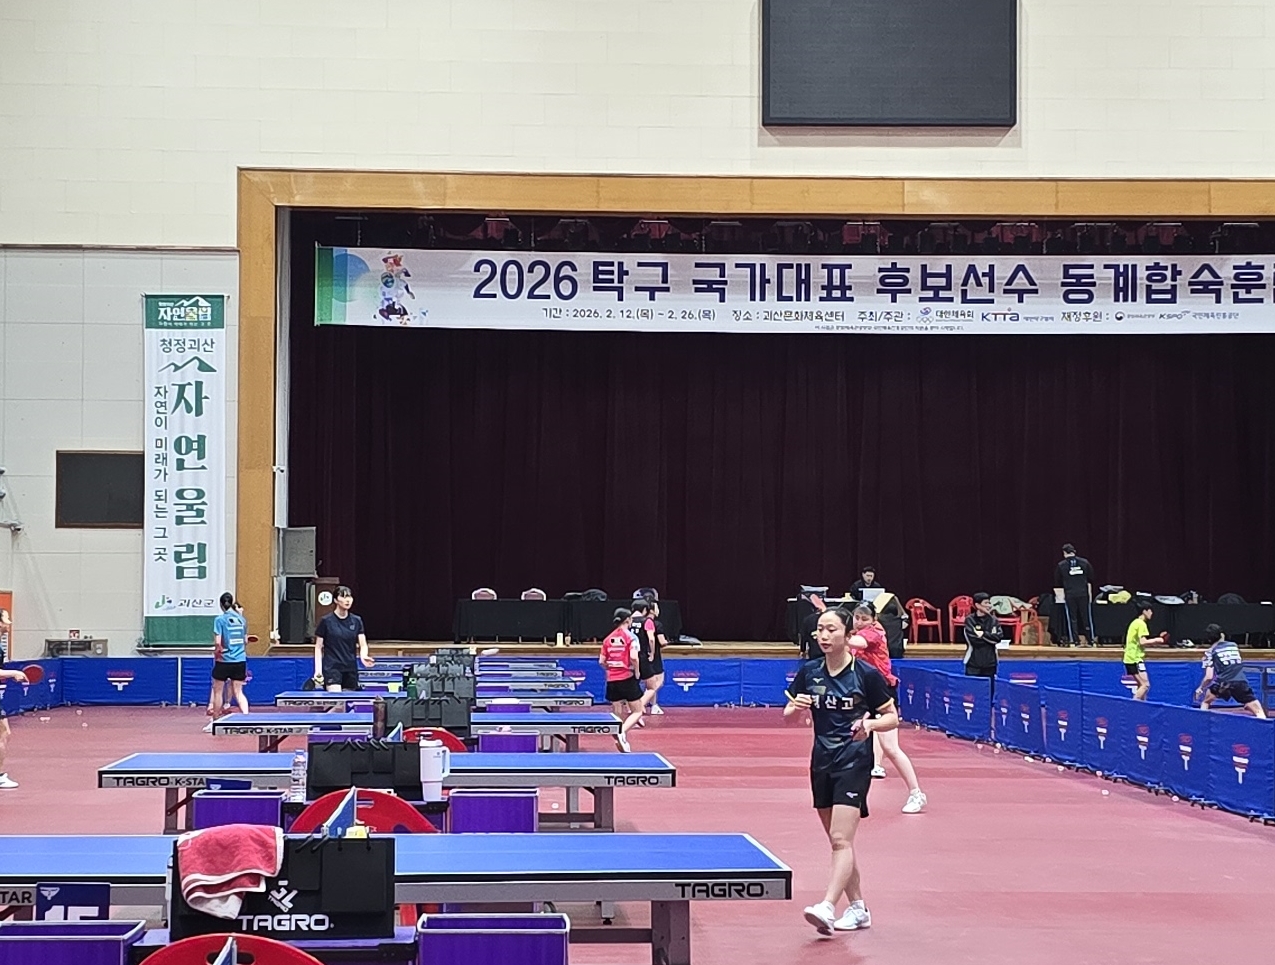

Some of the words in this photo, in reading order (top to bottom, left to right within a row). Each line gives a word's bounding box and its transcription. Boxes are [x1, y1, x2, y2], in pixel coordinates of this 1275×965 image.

[473, 259, 578, 299] 2026
[592, 260, 672, 302] 탁구
[691, 262, 855, 303] 국가대표
[876, 262, 1040, 304] 후보선수
[542, 308, 562, 318] 기간
[573, 309, 602, 318] 2026.
[732, 310, 752, 321] 장소
[858, 311, 903, 322] 주최/주관
[1061, 311, 1102, 322] 재정후원
[159, 337, 215, 353] 청정괴산
[154, 385, 169, 430] 자연이
[154, 439, 169, 483] 미래가
[170, 380, 210, 580] 자연울림
[154, 489, 169, 519] 되는
[153, 526, 169, 539] 그
[153, 547, 169, 562] 곳
[177, 598, 215, 609] 괴산군
[571, 726, 611, 734] TAGRO
[112, 777, 170, 787] TAGRO
[175, 778, 206, 787] K-STA
[603, 775, 659, 786] TAGRO
[675, 882, 765, 899] TAGRO
[237, 914, 330, 931] TAGRO
